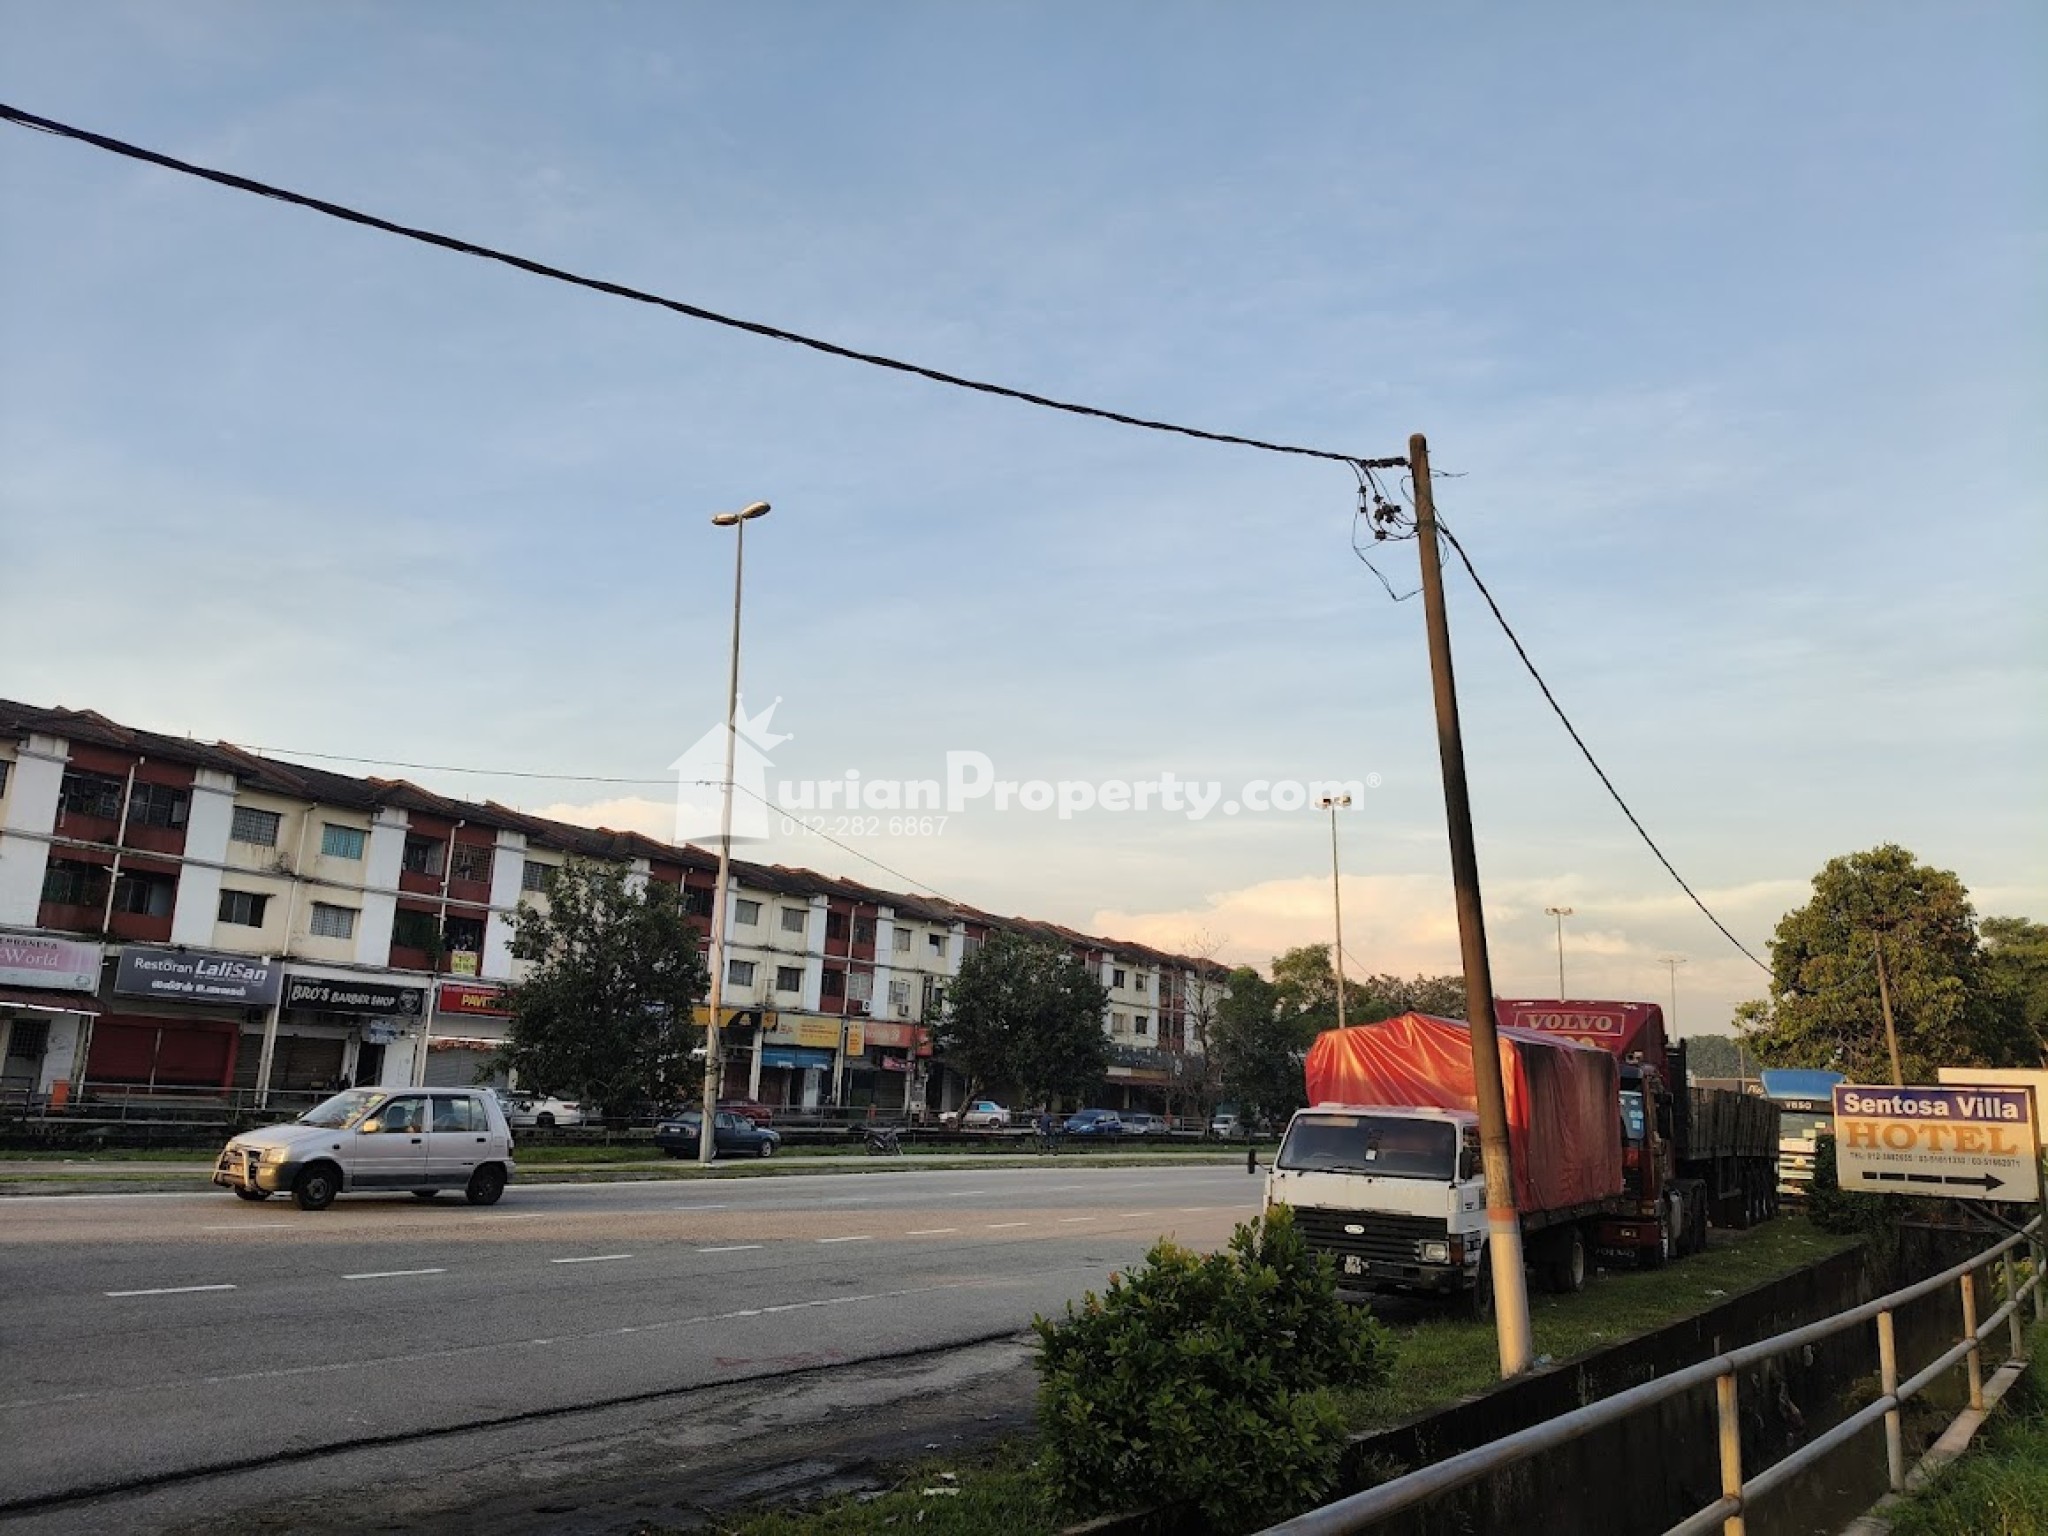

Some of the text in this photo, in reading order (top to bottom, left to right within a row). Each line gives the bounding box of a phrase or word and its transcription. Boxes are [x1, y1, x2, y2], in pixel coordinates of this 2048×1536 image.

[5, 948, 58, 967] World
[134, 957, 193, 973] Restoran
[371, 994, 395, 1007] SHOP
[1526, 1014, 1612, 1031] VOLVO
[1844, 1093, 2019, 1119] Sentosa Villa
[1844, 1121, 2021, 1156] HOTEL
